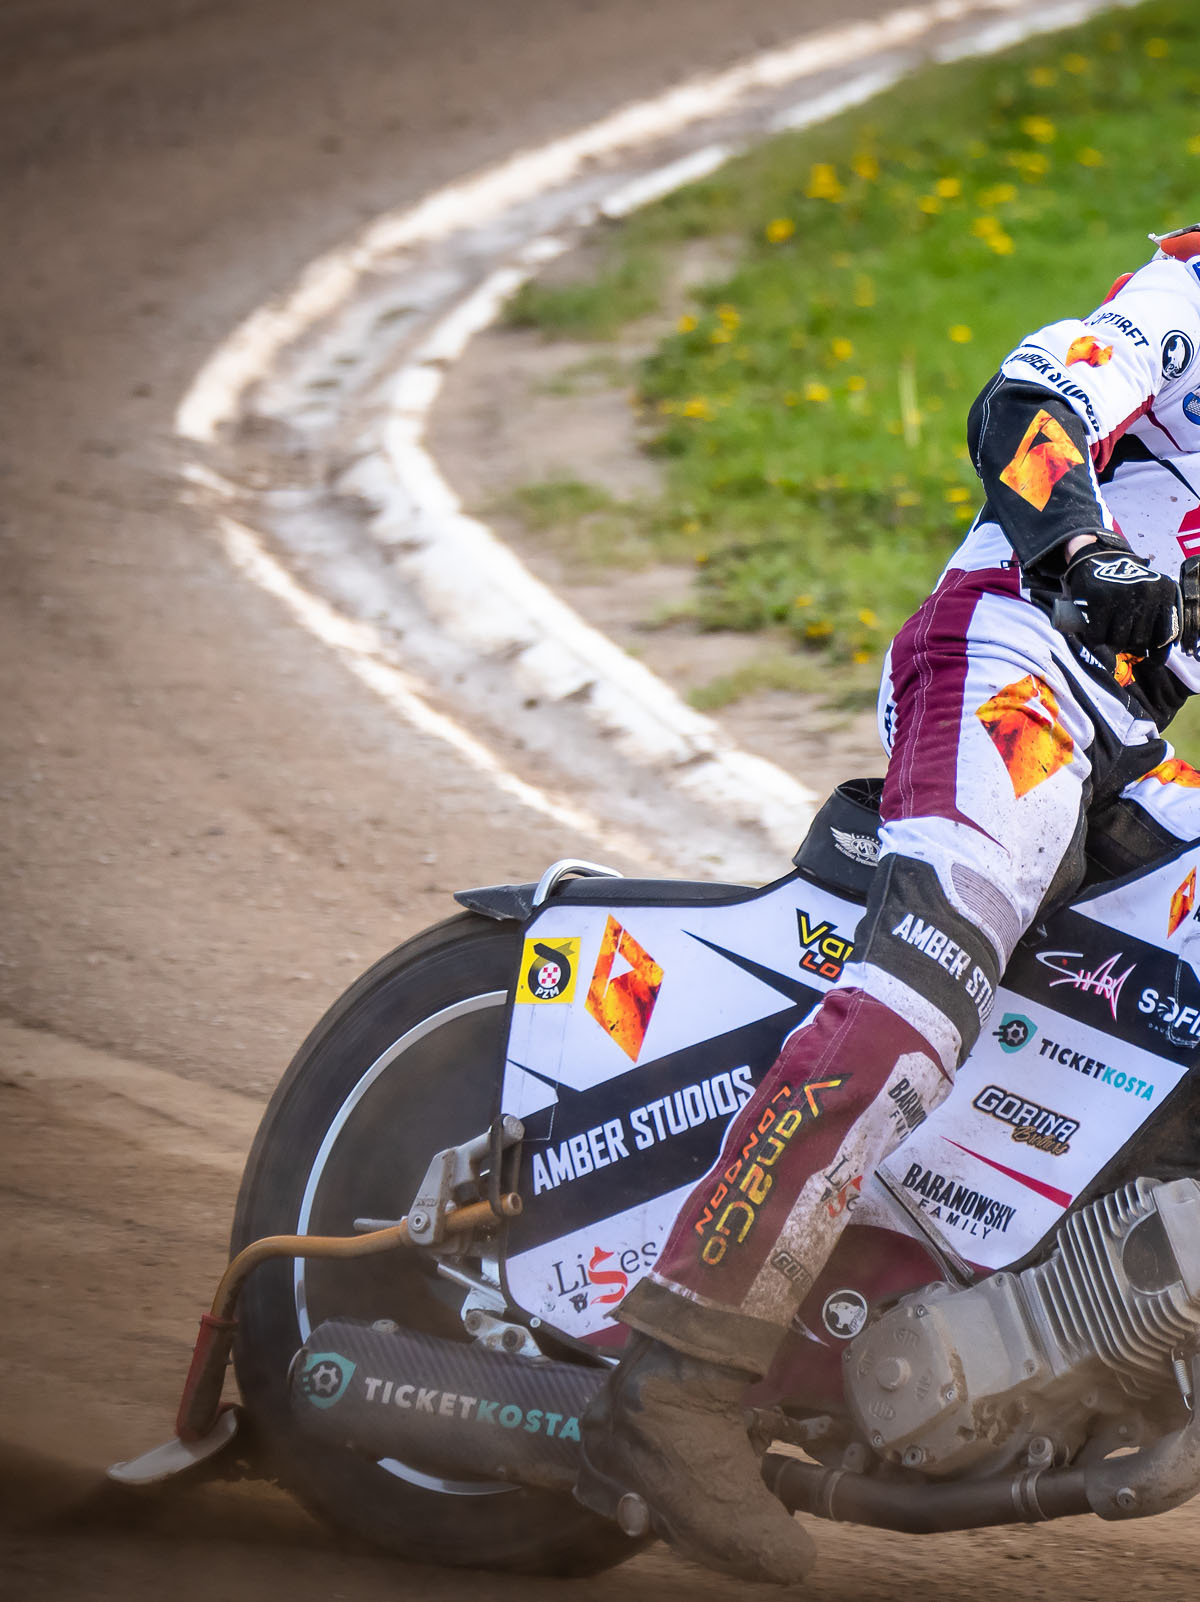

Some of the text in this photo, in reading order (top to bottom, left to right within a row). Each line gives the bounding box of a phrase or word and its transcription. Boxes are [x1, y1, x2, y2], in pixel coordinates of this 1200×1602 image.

[892, 913, 972, 981] AMBER
[535, 986, 560, 999] PZM
[1039, 1037, 1157, 1102] TICKETKOSTA
[532, 1064, 757, 1196] AMBER STUDIOS
[975, 1087, 1079, 1143] GORINA
[917, 1200, 992, 1241] FAMILY
[364, 1376, 582, 1443] TICKETKOSTA
